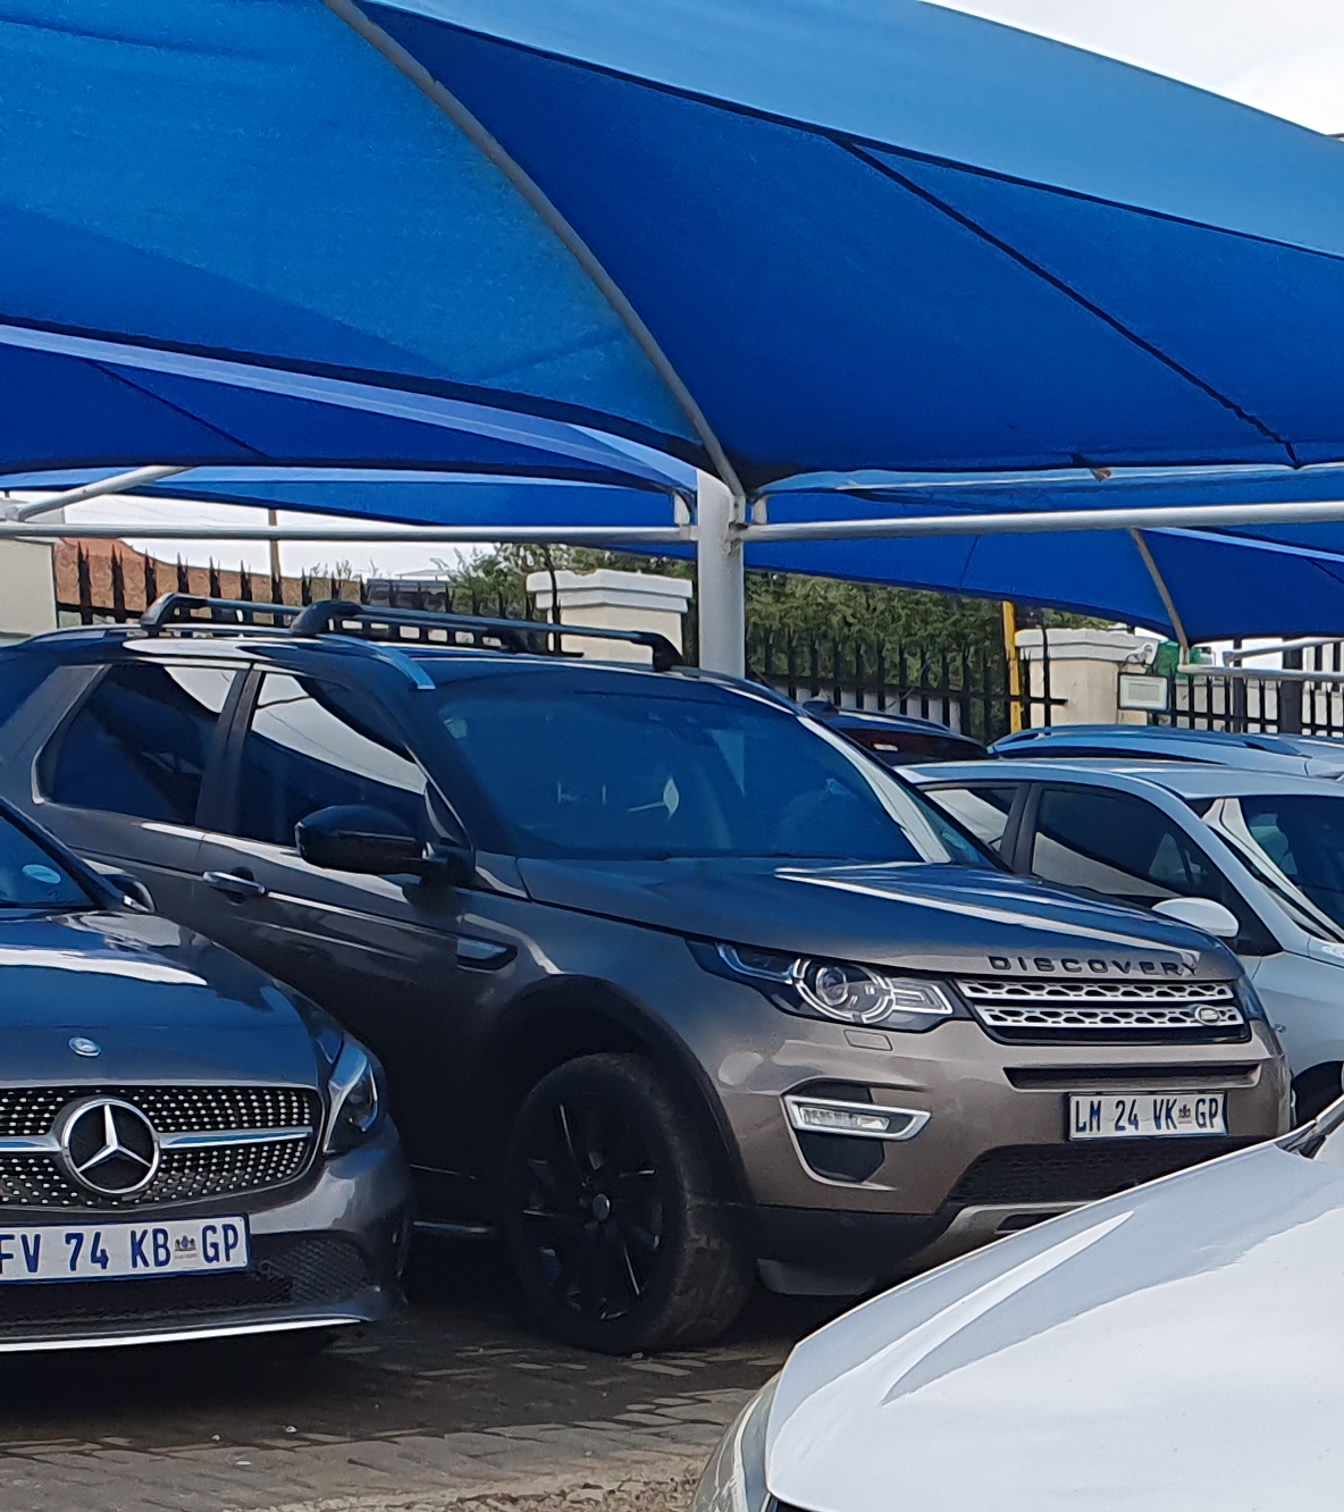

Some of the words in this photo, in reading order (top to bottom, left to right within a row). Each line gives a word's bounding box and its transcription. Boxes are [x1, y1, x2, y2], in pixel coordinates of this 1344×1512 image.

[988, 955, 1199, 977] DISCOVERY
[1075, 1100, 1102, 1133] LM
[1114, 1098, 1139, 1132] 24
[1153, 1098, 1177, 1131] VK
[1195, 1097, 1219, 1129] GP
[65, 1231, 109, 1272] 74
[130, 1227, 171, 1268] KB
[201, 1223, 239, 1264] GP
